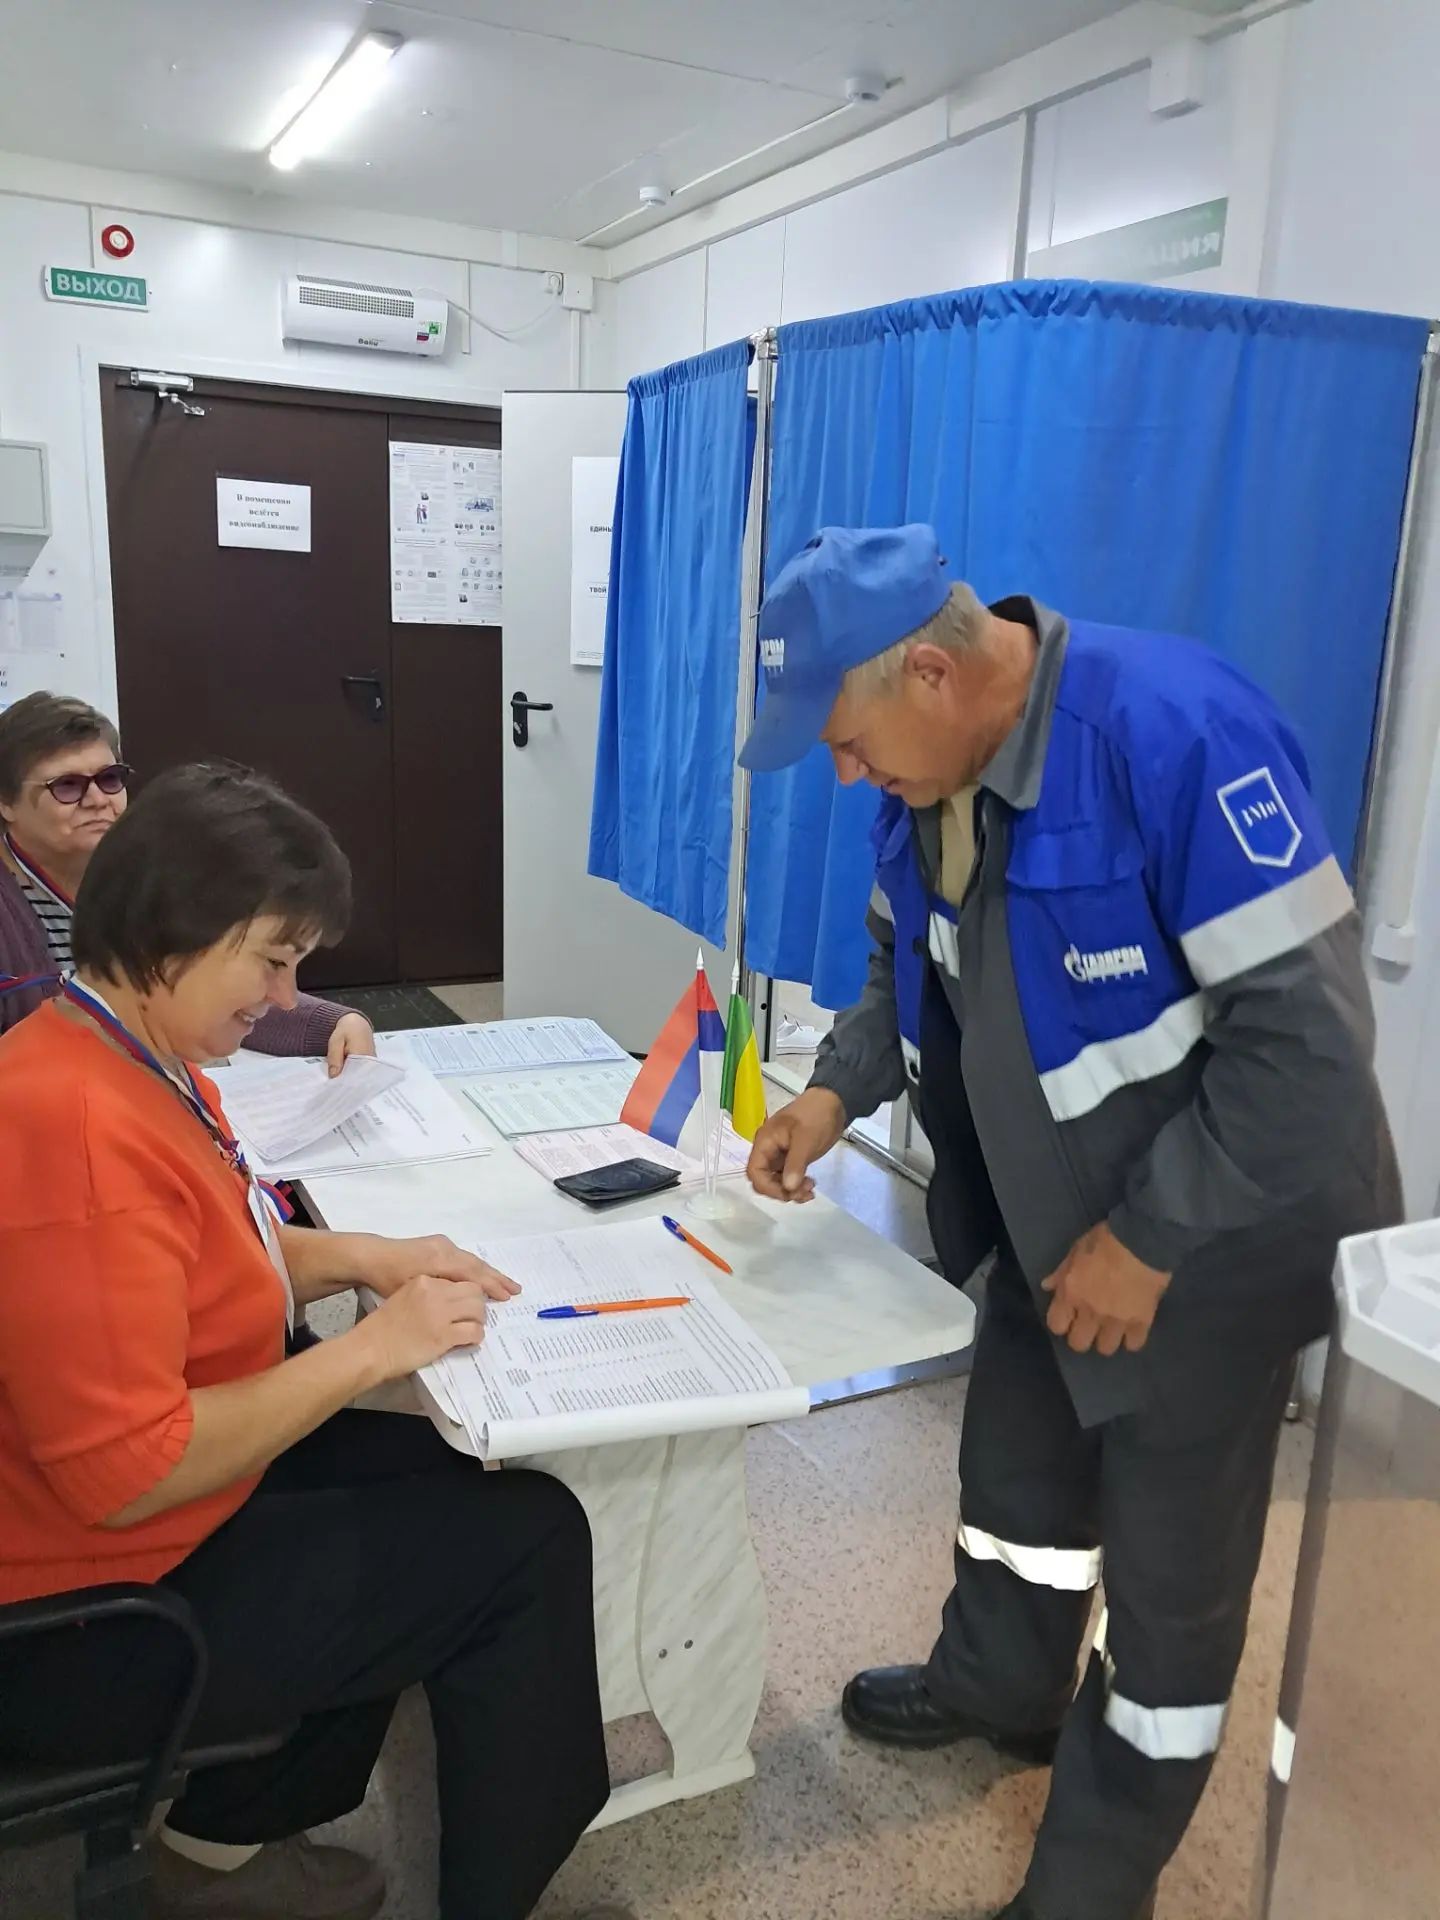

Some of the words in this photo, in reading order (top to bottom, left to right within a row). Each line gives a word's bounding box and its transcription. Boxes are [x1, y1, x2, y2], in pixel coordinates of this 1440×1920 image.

[56, 273, 141, 300] ВЫХОД
[590, 525, 612, 533] ЕДИНЫ
[589, 586, 607, 594] ТВОЙ
